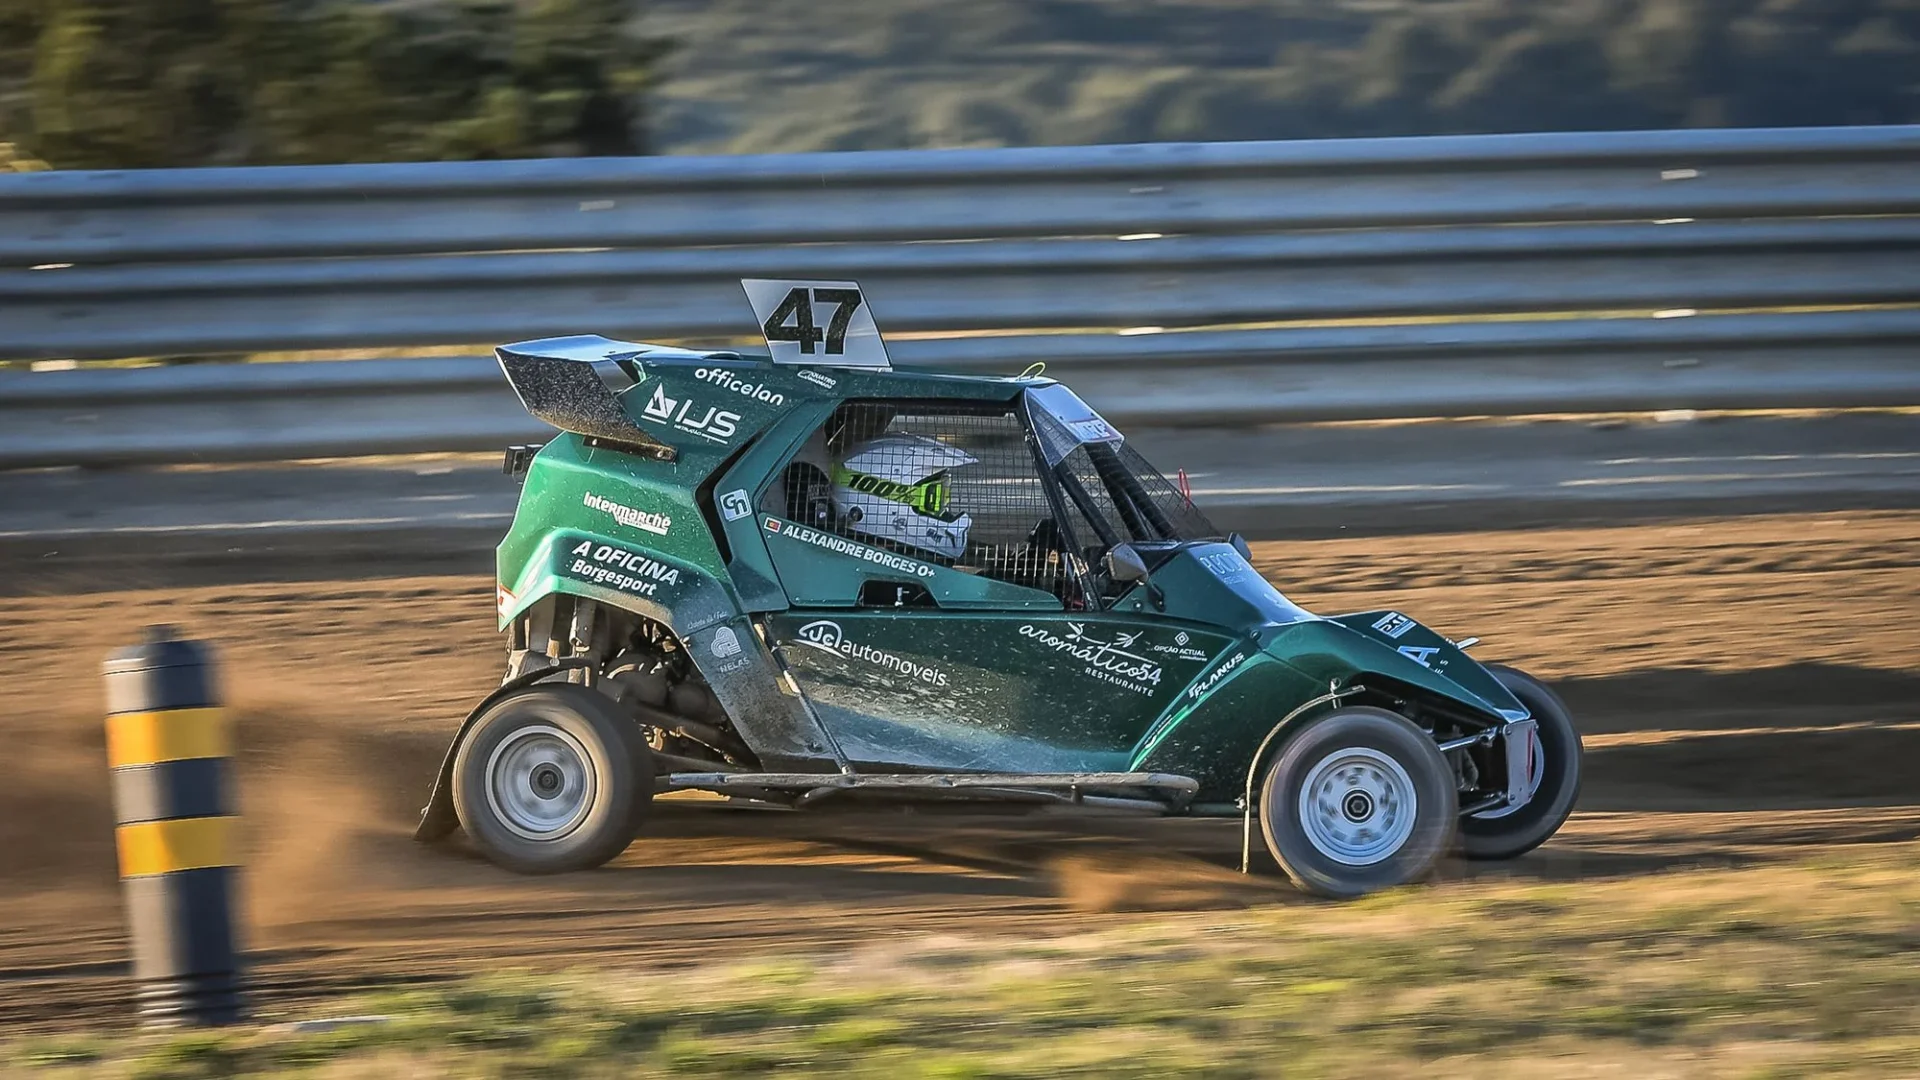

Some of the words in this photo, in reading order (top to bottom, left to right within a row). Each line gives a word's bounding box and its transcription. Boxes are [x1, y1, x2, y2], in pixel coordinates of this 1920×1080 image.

[763, 287, 862, 354] 47
[694, 368, 784, 406] officelan
[572, 541, 592, 557] A
[593, 545, 679, 586] OFICINA
[783, 525, 864, 558] ALEXANDRE
[863, 549, 917, 574] BORGES
[571, 559, 657, 596] Borgesport
[1085, 667, 1154, 697] RESTAURANTE
